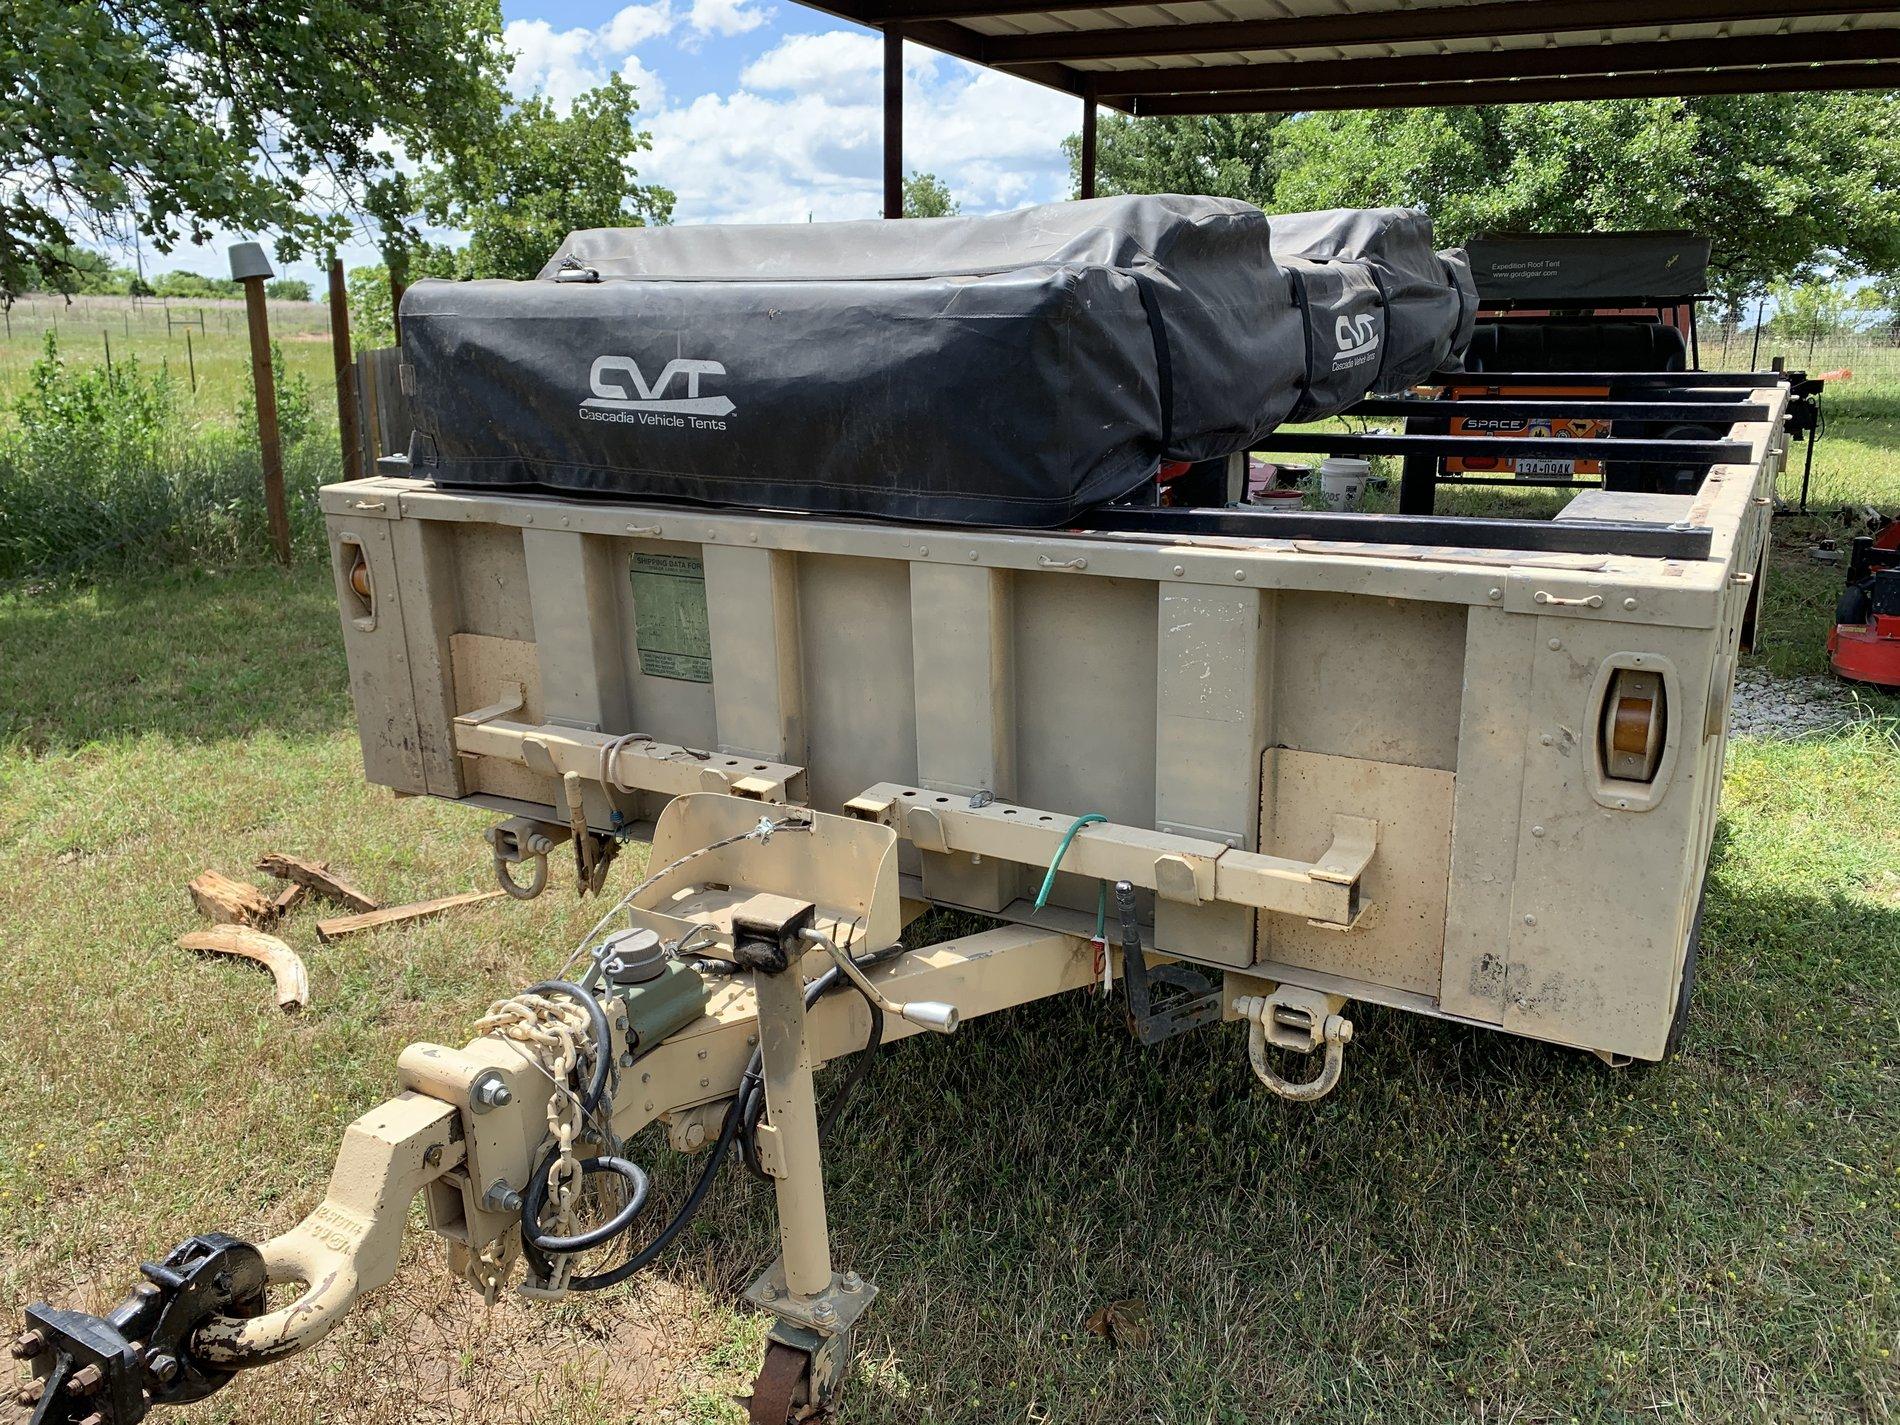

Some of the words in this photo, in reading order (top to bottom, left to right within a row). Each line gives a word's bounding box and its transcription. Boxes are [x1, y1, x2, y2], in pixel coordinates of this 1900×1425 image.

[1491, 262, 1526, 271] Expedition
[1527, 261, 1544, 269] Roof
[1544, 260, 1560, 268] Tent
[1335, 313, 1375, 350] CVT
[589, 355, 727, 400] CVT
[578, 408, 635, 424] Cascadia
[637, 412, 685, 428] Vehicle
[687, 416, 727, 431] Tents
[1467, 419, 1521, 429] SPACE
[636, 556, 668, 567] SHIPPING
[669, 560, 686, 569] DATA
